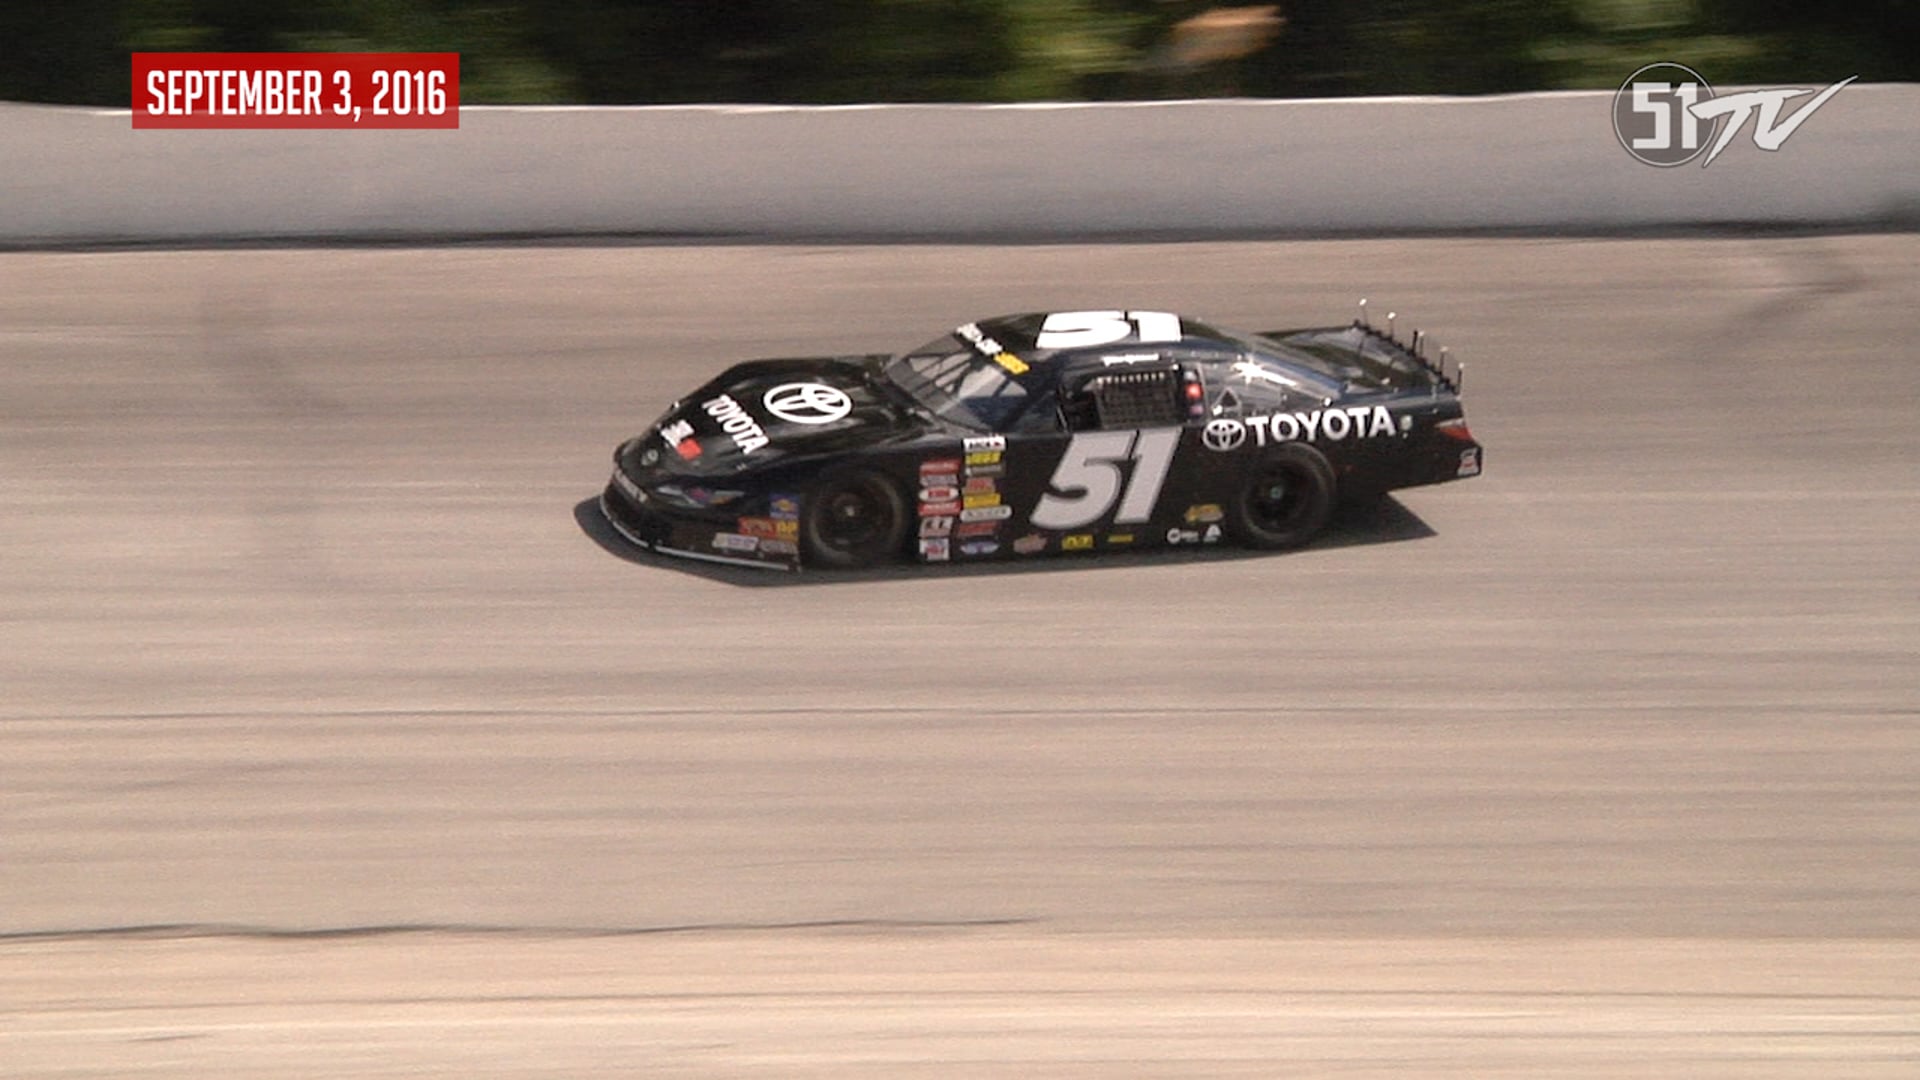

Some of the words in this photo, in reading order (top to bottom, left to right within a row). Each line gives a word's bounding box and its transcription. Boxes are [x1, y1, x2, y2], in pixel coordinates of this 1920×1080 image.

[1036, 310, 1181, 349] 51
[702, 394, 769, 455] TOYOTA
[1246, 406, 1396, 446] TOYOTA
[1029, 426, 1183, 530] 51
